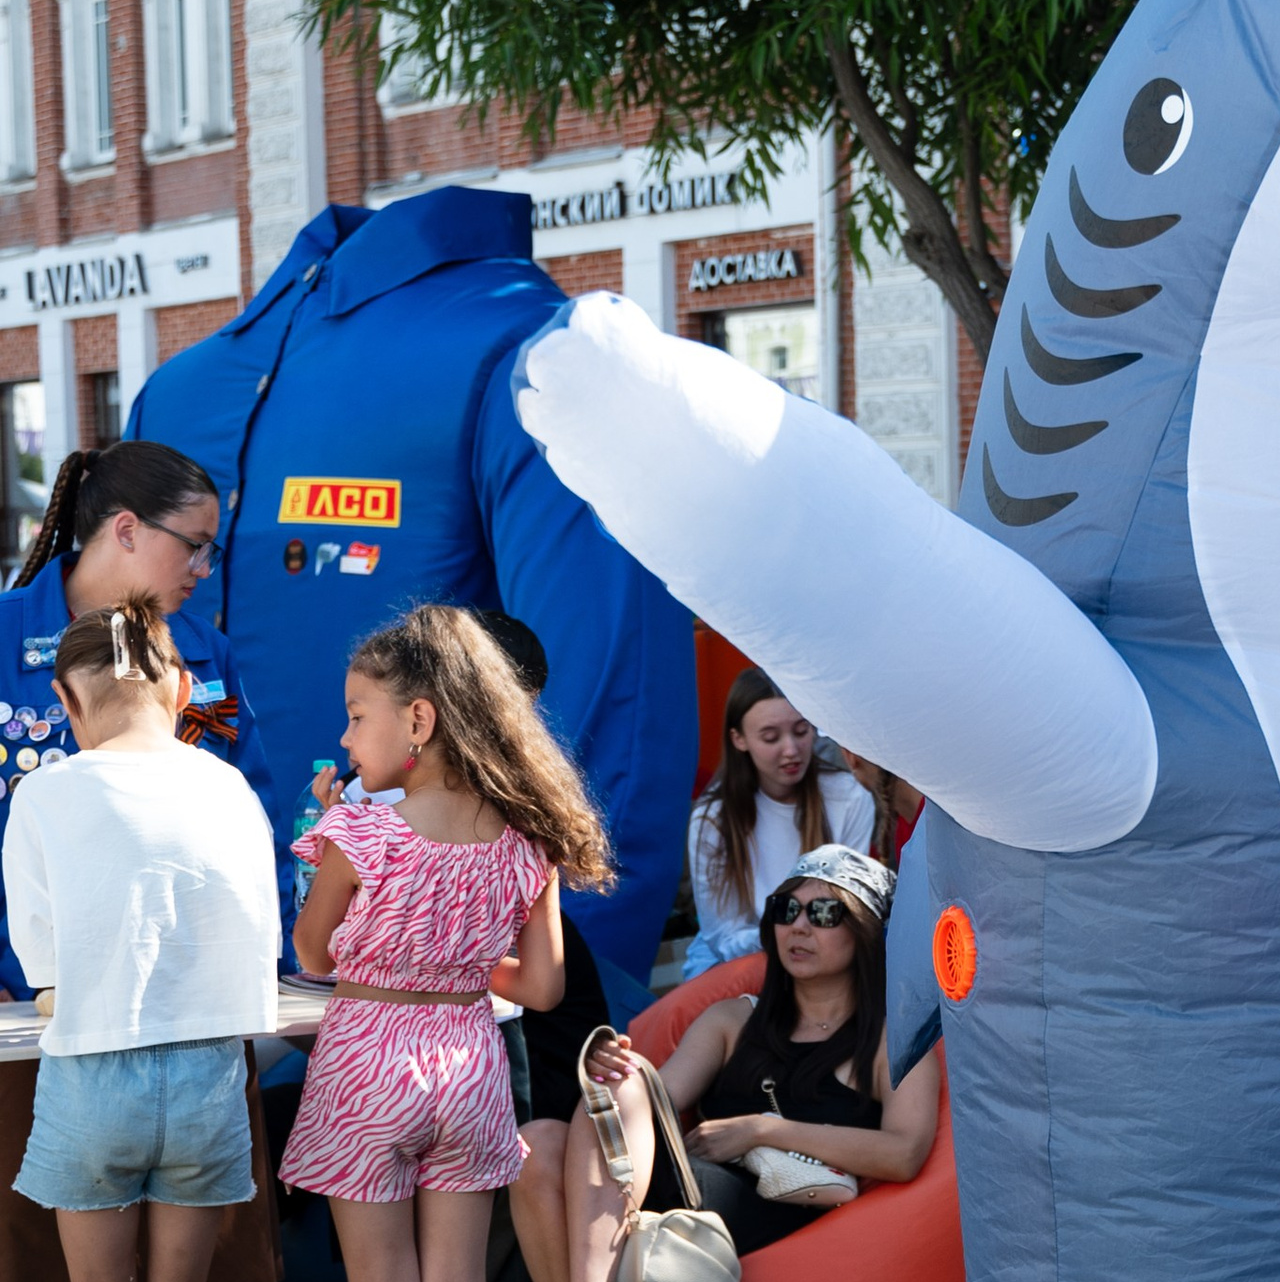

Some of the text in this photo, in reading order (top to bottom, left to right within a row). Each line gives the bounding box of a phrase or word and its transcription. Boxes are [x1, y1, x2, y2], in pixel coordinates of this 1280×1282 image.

[533, 181, 624, 229] НСКИЙ
[26, 253, 148, 311] LAVANDA
[689, 249, 800, 292] ДОСТАВКА
